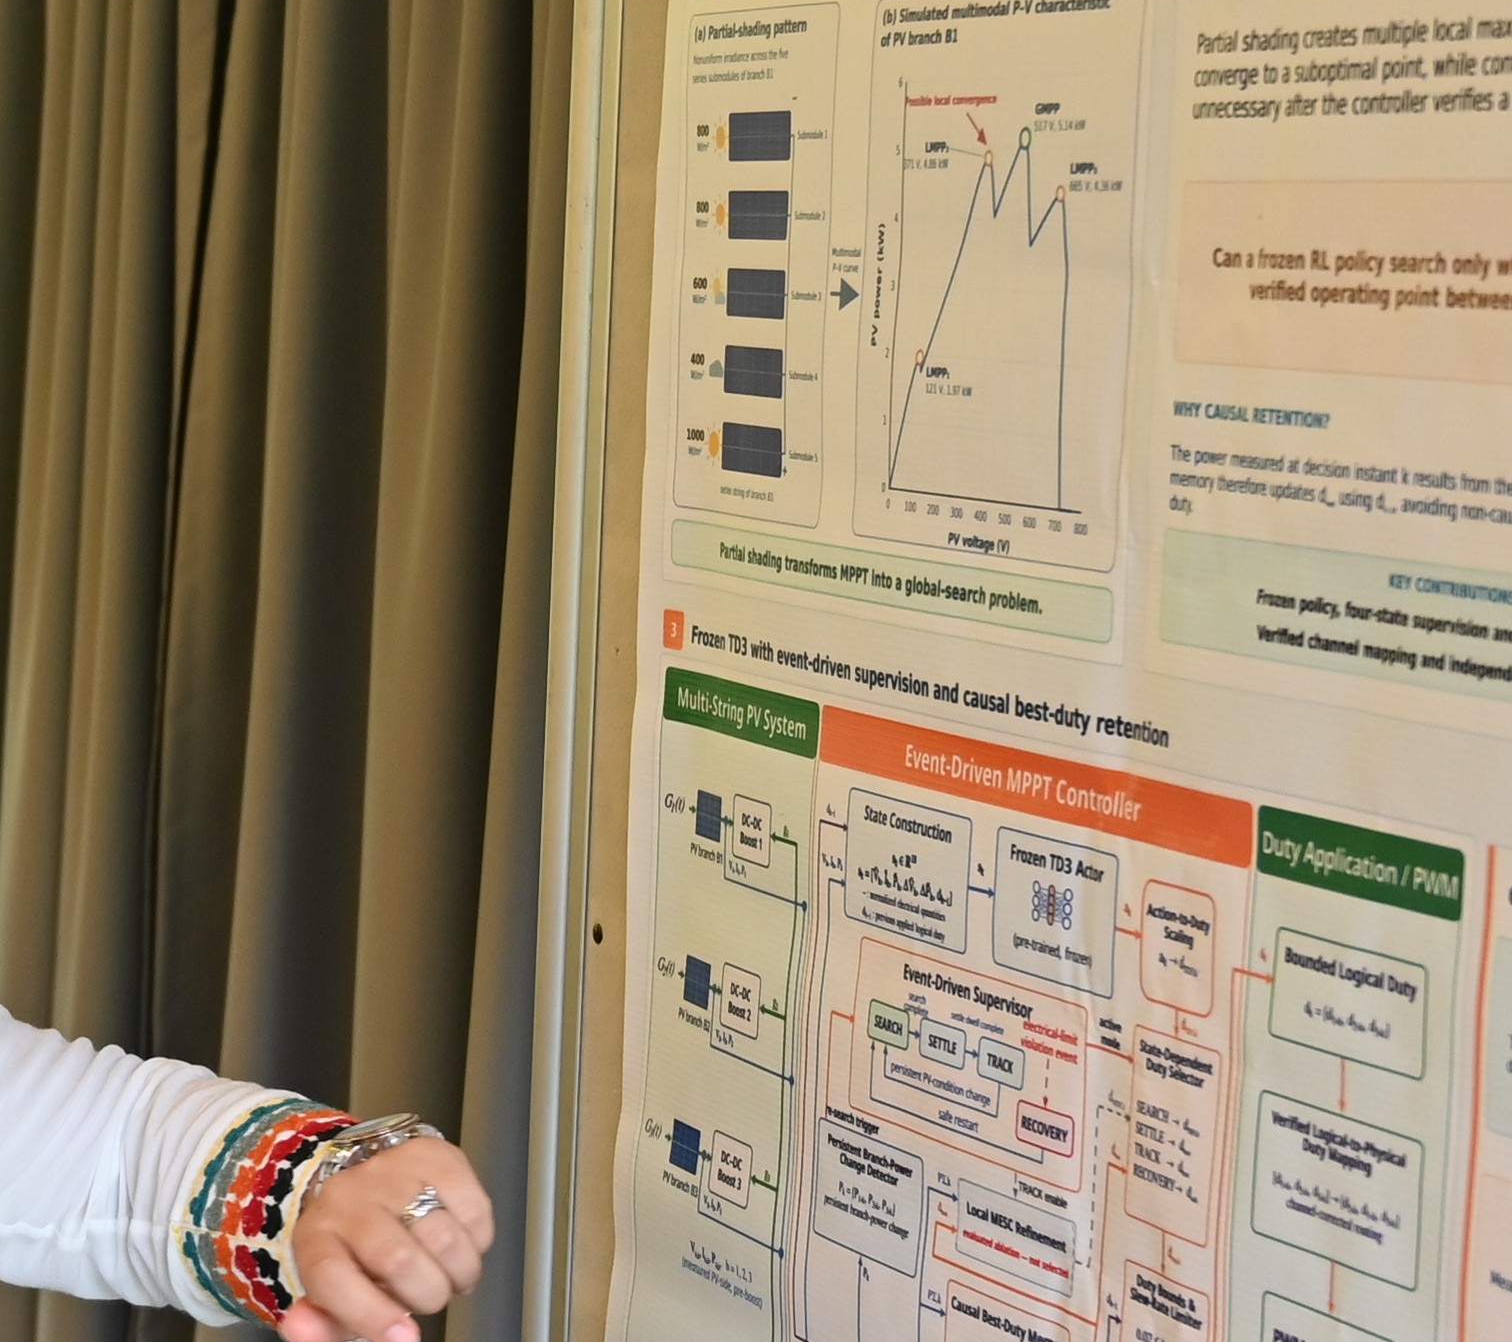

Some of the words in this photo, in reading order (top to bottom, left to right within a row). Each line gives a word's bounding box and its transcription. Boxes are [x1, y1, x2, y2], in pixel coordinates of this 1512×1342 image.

[693, 24, 708, 45] (a)
[707, 20, 773, 41] Partial-shading
[772, 18, 809, 39] pattern
[718, 541, 747, 563] Partial
[746, 547, 783, 575] shading
[783, 554, 838, 581] transforms
[839, 563, 870, 586] MPPT
[870, 568, 894, 590] into
[894, 575, 903, 592] a
[904, 575, 987, 605] global-search
[987, 590, 1043, 615] problem.
[669, 620, 678, 639] 3
[690, 624, 727, 651] Frozen
[727, 632, 749, 657] TD3
[749, 639, 775, 663] with
[776, 649, 852, 681] event-driven
[853, 666, 930, 698] supervision
[932, 681, 960, 705] and
[962, 689, 1011, 715] causal
[1013, 694, 1091, 737] best-duty
[1095, 715, 1170, 748] retention
[676, 686, 745, 730] Multi-String
[745, 703, 763, 729] PV
[762, 708, 807, 741] System
[904, 743, 1003, 789] Event-Driven
[1005, 767, 1053, 801] MPPT
[1055, 779, 1142, 822] Controller
[863, 804, 889, 827] State
[888, 811, 953, 844] Construction
[1009, 842, 1048, 869] Frozen
[1049, 852, 1074, 876] TD3
[1074, 859, 1105, 884] Actor
[1261, 830, 1303, 868] Duty
[1303, 841, 1399, 885] Application
[1399, 864, 1411, 887] /
[1412, 866, 1460, 900] PWM
[873, 1013, 904, 1037] SEARCH
[927, 1033, 958, 1056] SETTLE
[986, 1051, 1015, 1075] TRACK
[1020, 1114, 1069, 1144] RECOVERY
